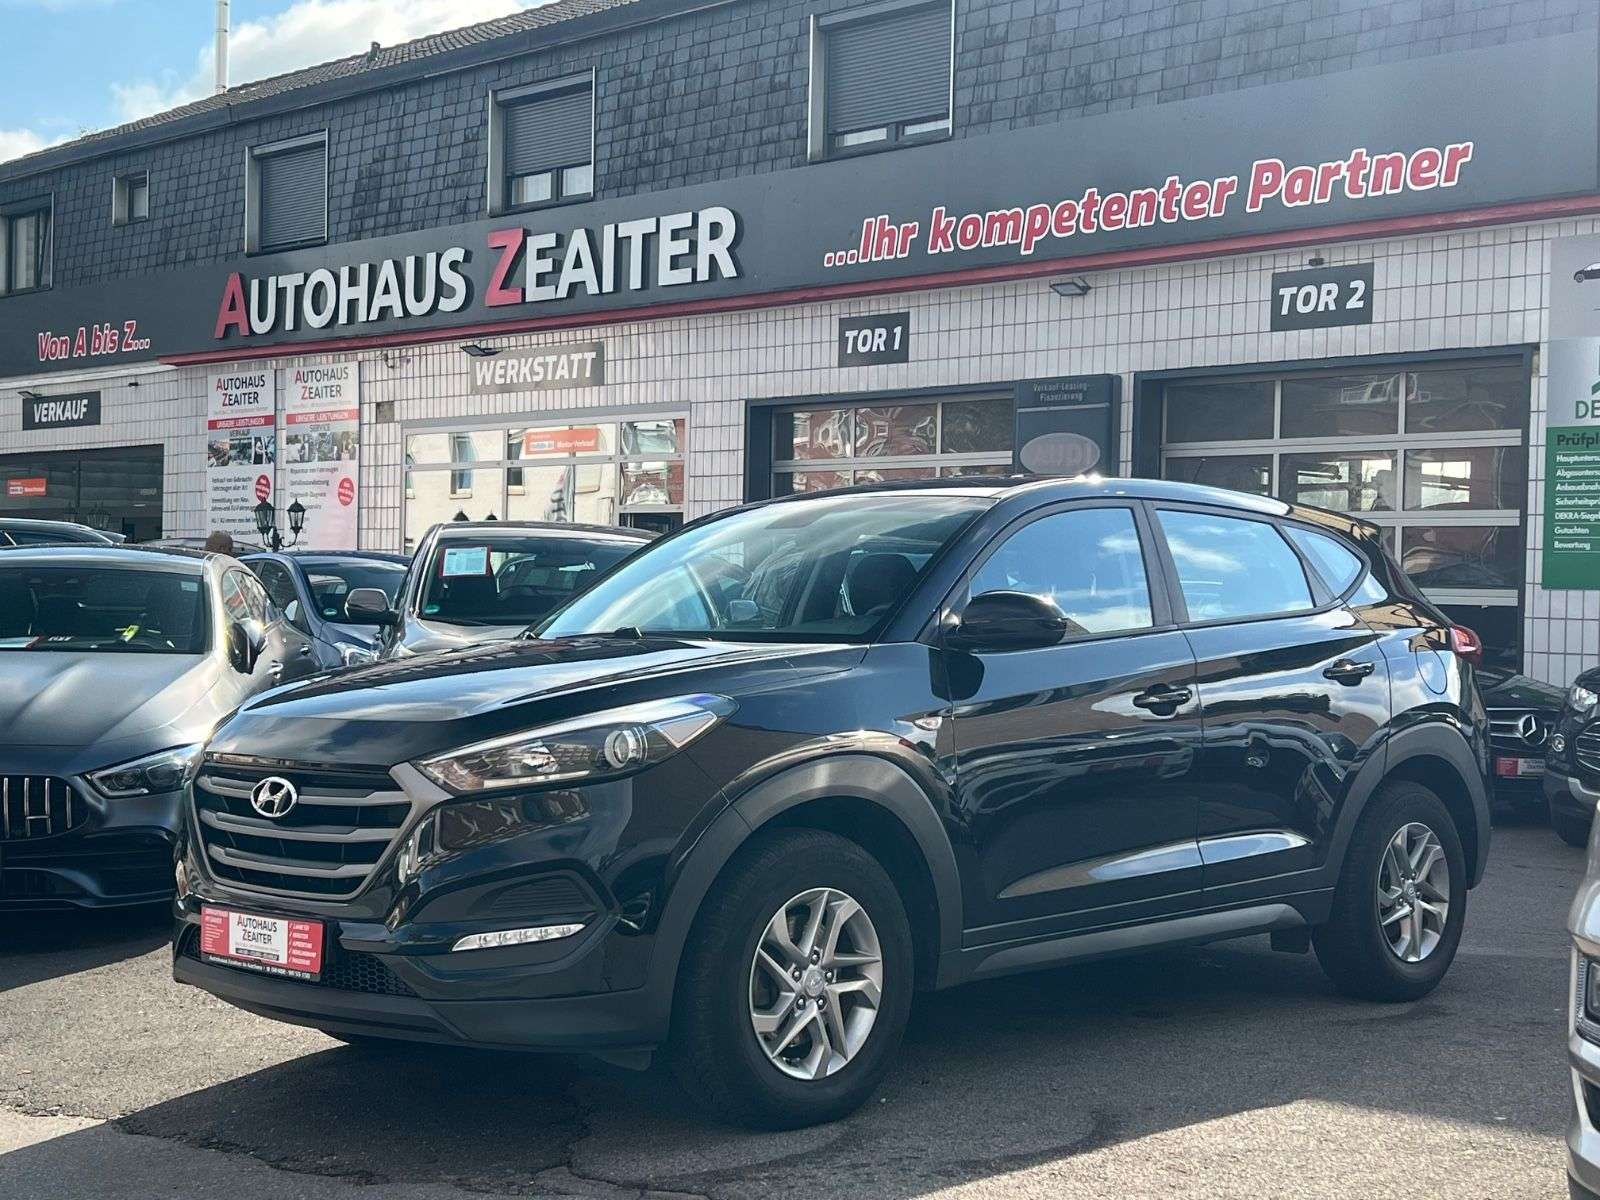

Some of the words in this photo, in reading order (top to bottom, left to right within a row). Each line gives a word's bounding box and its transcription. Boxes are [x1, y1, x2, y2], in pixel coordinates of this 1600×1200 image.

[823, 215, 918, 267] ...Ihr
[928, 176, 1239, 255] kompetenter
[1246, 142, 1474, 213] Partner
[214, 246, 468, 339] AUTOHAUS
[485, 206, 739, 307] ZEAITER
[1279, 283, 1339, 316] TOR
[1345, 279, 1366, 310] 2
[38, 331, 70, 362] Von
[73, 327, 86, 358] A
[91, 323, 119, 355] bis
[845, 328, 887, 354] TOR
[893, 325, 903, 351] 1
[295, 366, 349, 384] AUTOHAUS
[475, 351, 597, 386] WERKSTATT
[216, 375, 266, 391] AUTOHAUS
[301, 384, 342, 400] ZEAITER
[222, 391, 259, 407] ZEAITER
[33, 398, 89, 423] VERKAUF
[1557, 432, 1600, 448] Prüfpl
[1554, 526, 1590, 534] Gutachten
[1554, 540, 1591, 551] Bewertung
[237, 915, 278, 933] AUTOHAUS
[242, 929, 273, 945] ZEAITER
